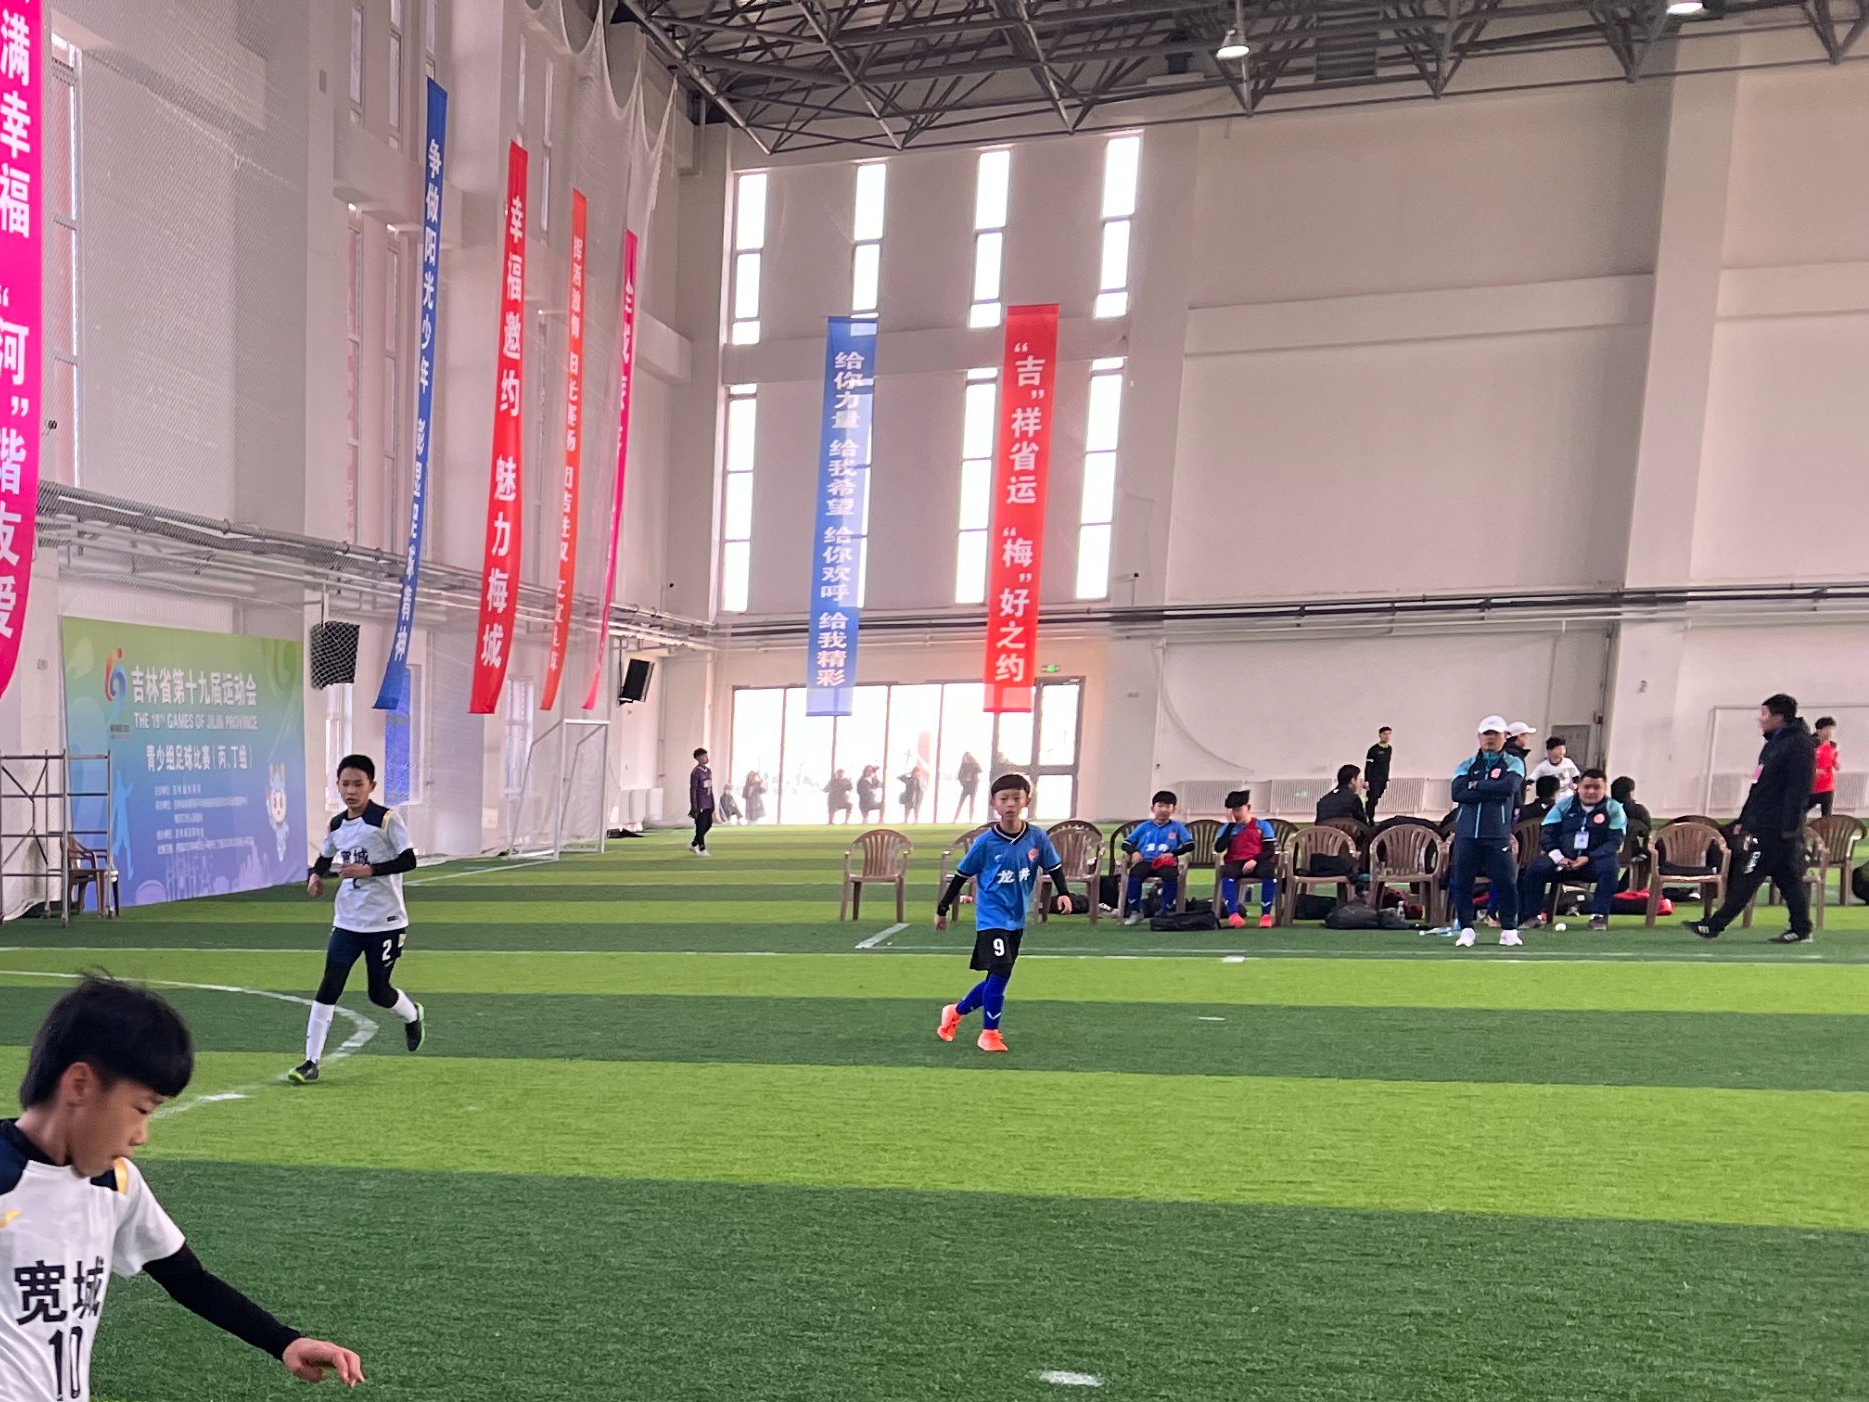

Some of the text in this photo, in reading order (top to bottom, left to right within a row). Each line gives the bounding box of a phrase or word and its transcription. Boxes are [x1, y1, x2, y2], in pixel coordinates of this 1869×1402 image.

[480, 195, 524, 669] 幸福邀约 魅力梅城
[815, 350, 866, 688] 给你力量 给我希望 给你欢呼 给我精彩
[994, 342, 1047, 684] “吉”祥省运 “梅”好之约
[131, 665, 258, 707] 吉林省第十九届运动会
[134, 712, 150, 729] THE
[167, 713, 194, 730] GAMES
[195, 714, 206, 730] OF
[381, 938, 393, 962] 2
[992, 937, 1006, 957] 9
[13, 1255, 106, 1326] 宽城
[48, 1325, 85, 1402] 10
